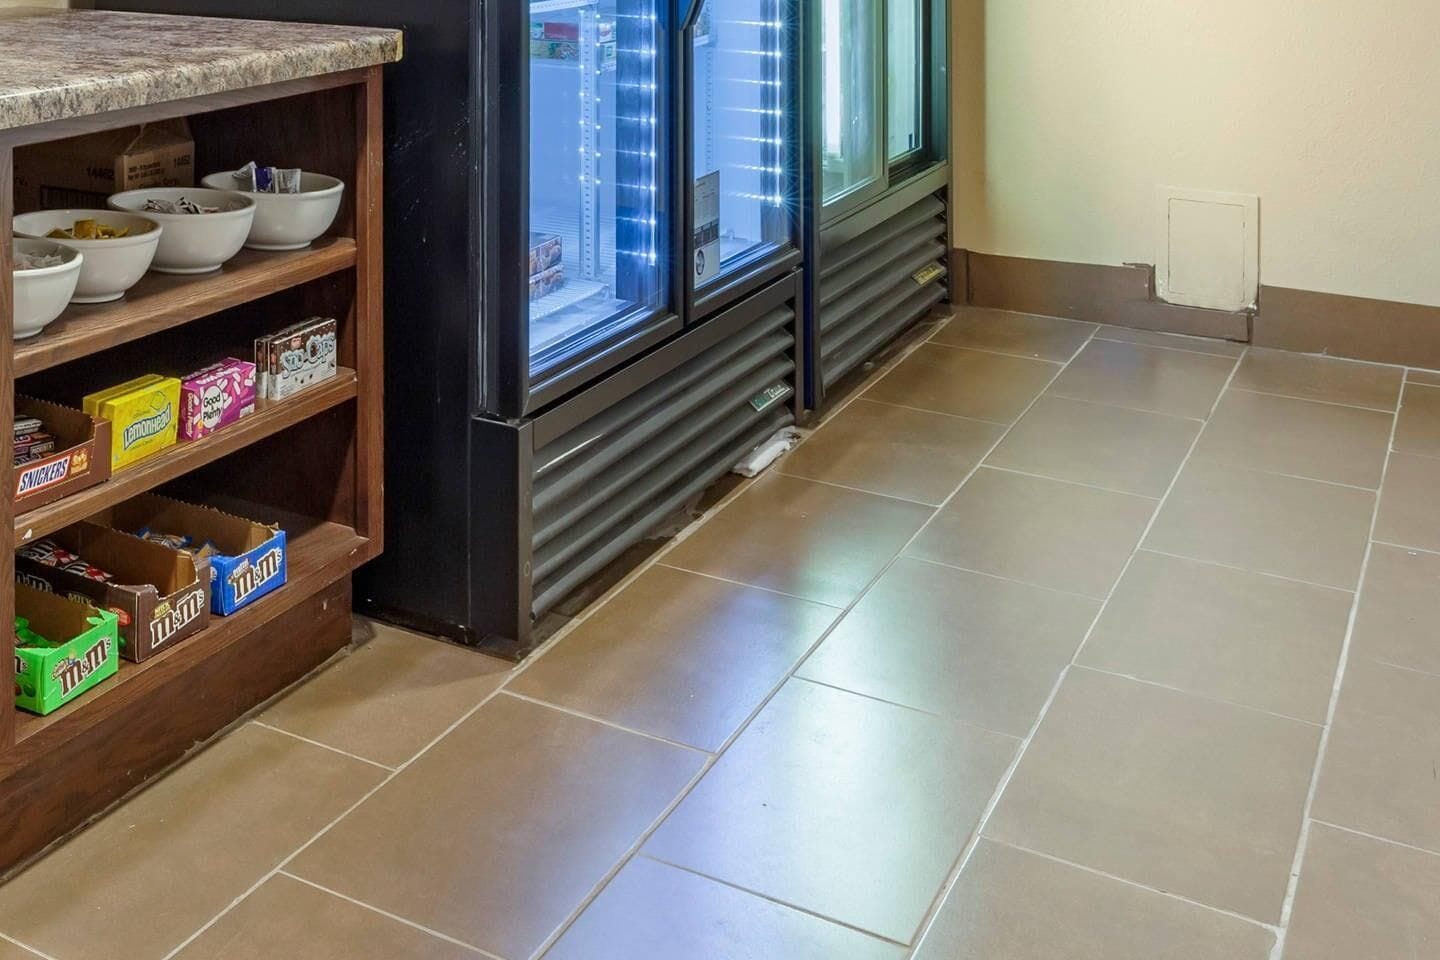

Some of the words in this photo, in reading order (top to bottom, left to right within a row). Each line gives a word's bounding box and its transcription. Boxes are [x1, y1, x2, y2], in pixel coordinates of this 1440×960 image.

[203, 393, 221, 408] Good
[203, 408, 222, 422] Plenty
[20, 458, 68, 492] SNICKERS
[234, 547, 282, 603] m&m's
[150, 589, 204, 648] m&m's
[60, 639, 111, 697] m&m's
